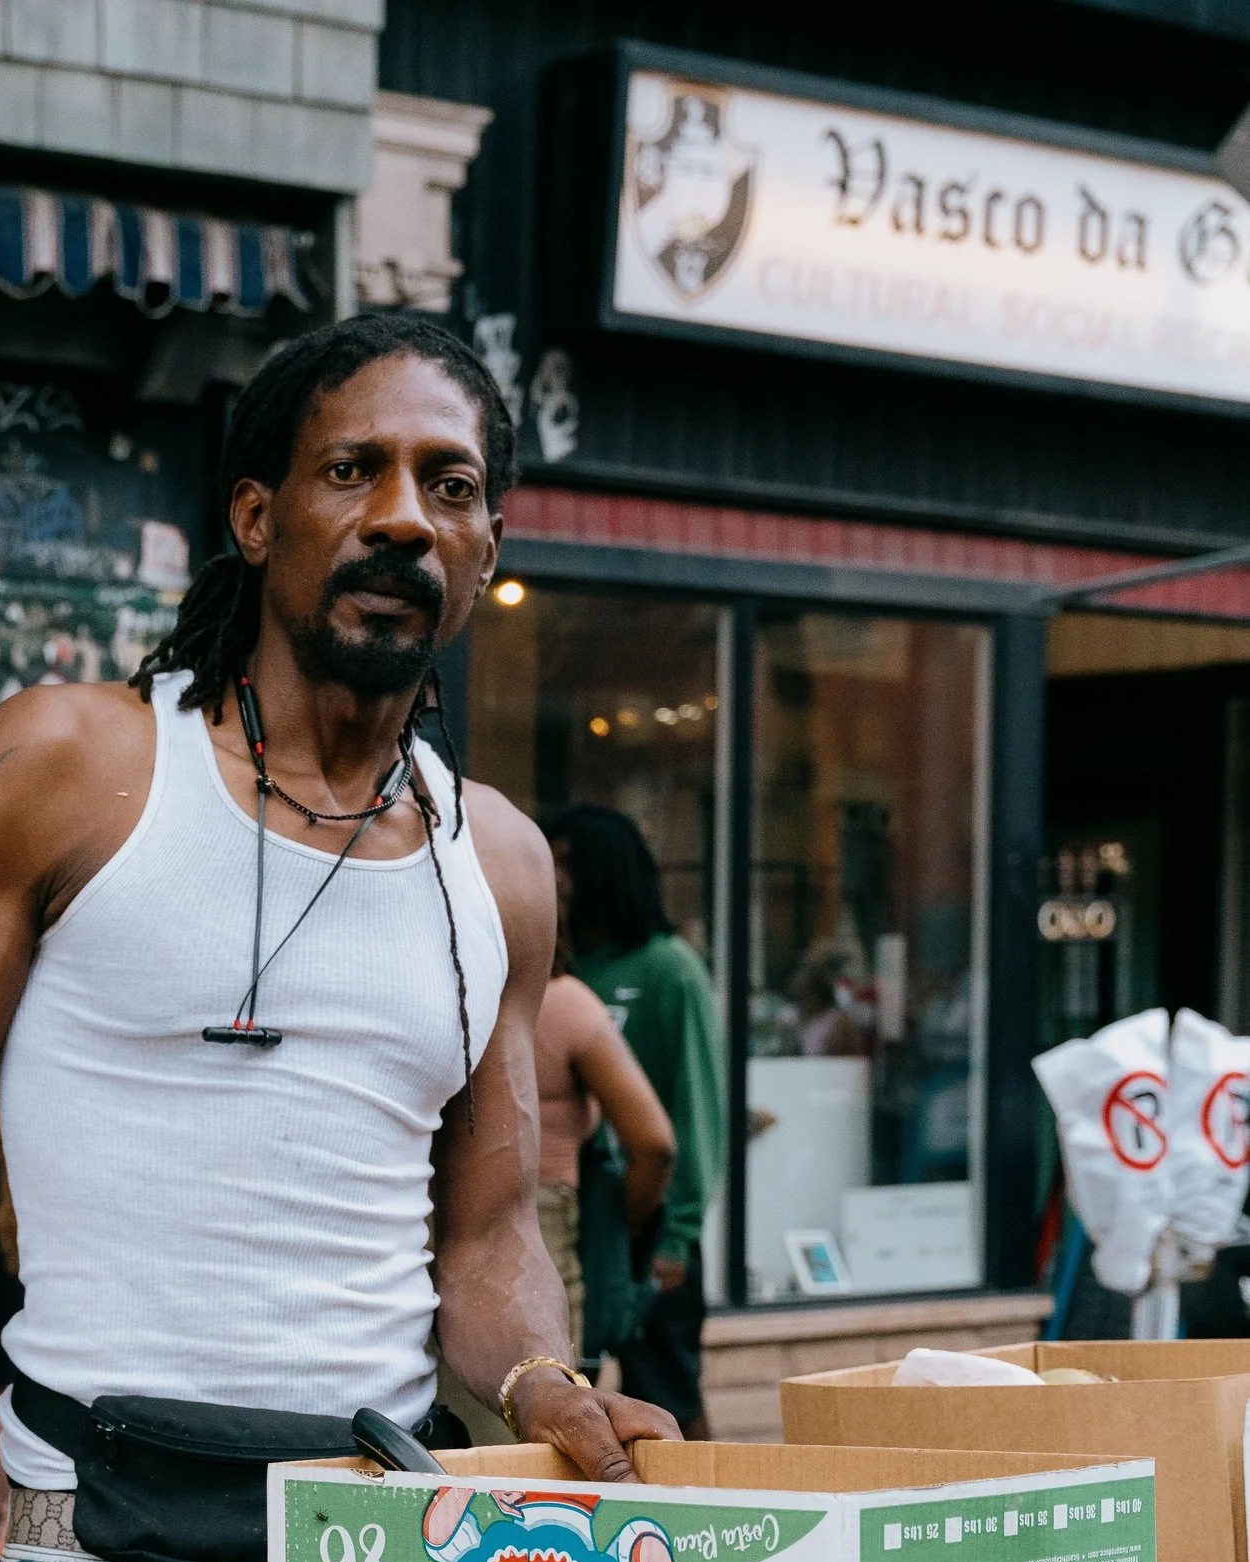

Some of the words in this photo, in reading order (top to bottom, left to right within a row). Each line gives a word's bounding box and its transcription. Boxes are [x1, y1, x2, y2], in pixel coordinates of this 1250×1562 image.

[824, 128, 1045, 254] Vasco
[1078, 183, 1150, 271] da
[1179, 198, 1250, 287] G
[1116, 1500, 1130, 1514] Lbs
[1132, 1499, 1142, 1513] 40
[1019, 1513, 1034, 1527] Lbs
[1069, 1507, 1084, 1521] Lbs
[927, 1523, 939, 1538] 25
[964, 1520, 981, 1535] Lbs
[986, 1518, 998, 1532] 30
[721, 1514, 780, 1552] Costa
[904, 1526, 922, 1541] Lbs
[674, 1524, 717, 1560] Rica
